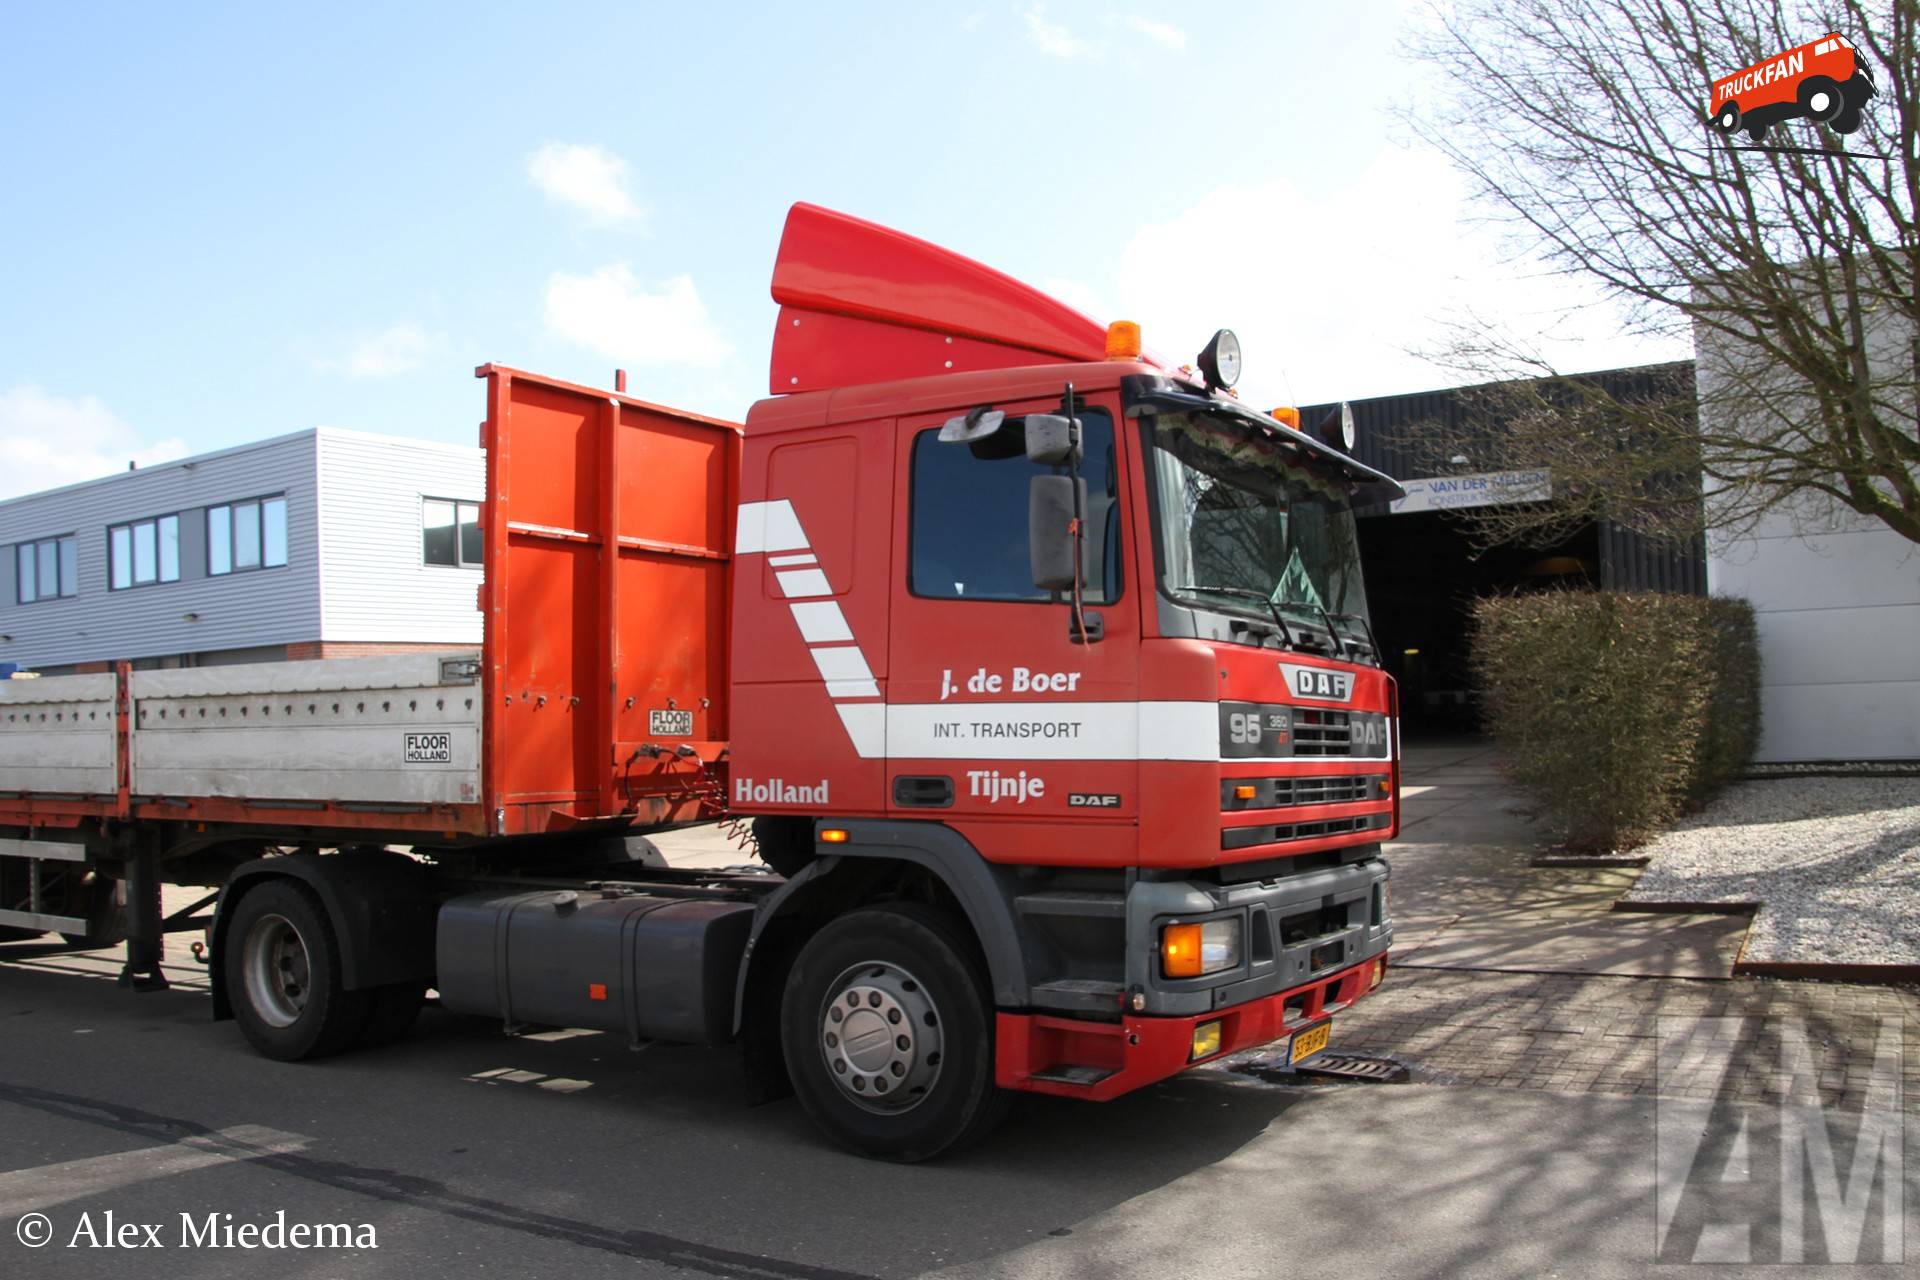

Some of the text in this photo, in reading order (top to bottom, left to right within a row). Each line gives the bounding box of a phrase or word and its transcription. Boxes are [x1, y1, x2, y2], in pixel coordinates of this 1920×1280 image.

[1428, 480, 1458, 494] VAN
[1462, 477, 1488, 490] DER
[940, 666, 1082, 700] J. de Boer
[1299, 671, 1346, 695] DAF
[652, 711, 691, 724] FLOOR
[652, 724, 691, 735] HOLLAND
[933, 721, 1082, 738] INT. TRANSPORT
[1229, 712, 1262, 744] 95
[1351, 720, 1386, 745] DAF
[407, 735, 448, 750] FLOOR
[407, 750, 448, 760] HOLLAND
[735, 778, 830, 804] Holland
[967, 770, 1045, 804] Tijnje
[1069, 795, 1118, 807] DAF
